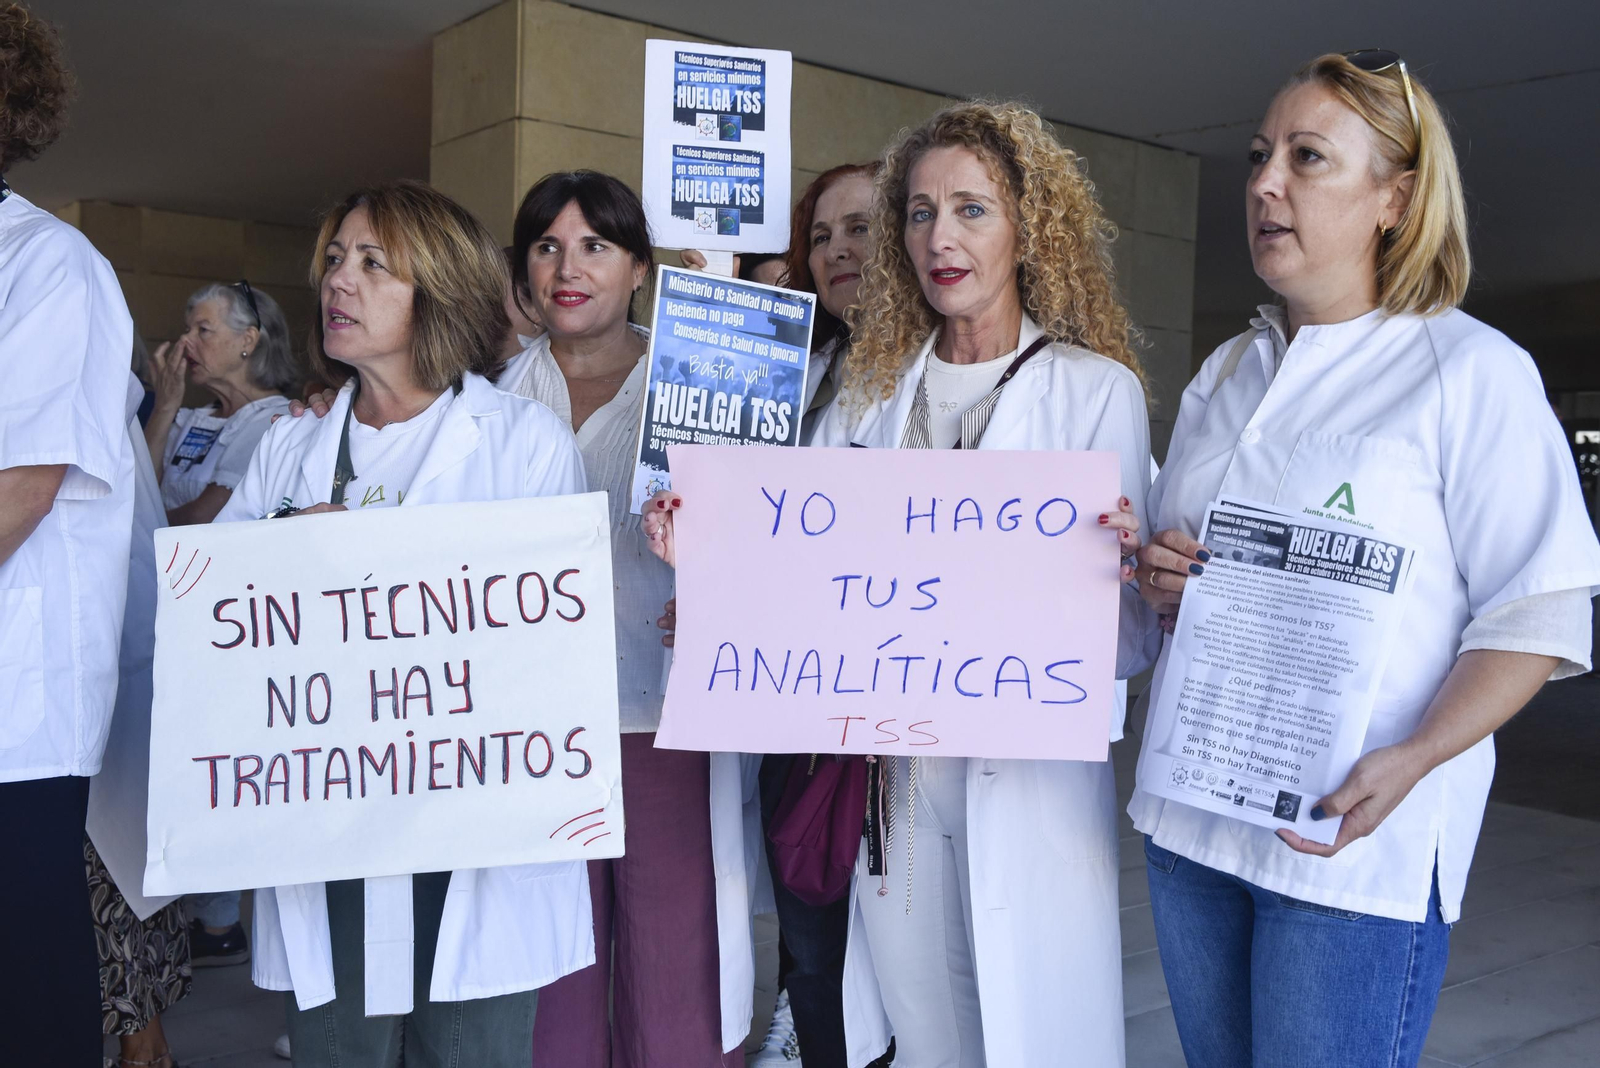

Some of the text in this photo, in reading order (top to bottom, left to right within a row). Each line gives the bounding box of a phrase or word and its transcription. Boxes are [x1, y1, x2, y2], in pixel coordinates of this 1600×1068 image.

[678, 53, 762, 72] Técnicos Superiores Sanitarios
[678, 71, 761, 85] en servicios mínimos
[677, 85, 762, 114] HUELGA TSS
[676, 147, 760, 165] Técnicos Superiores Sanitarios
[676, 164, 760, 178] en servicios mínimos
[675, 178, 760, 206] HUELGA TSS
[668, 275, 804, 320] Ministerio de Sanidad no cumple
[666, 302, 744, 326] Hacienda no paga
[674, 322, 799, 364] Consejerías de Salud nos ignoran
[689, 354, 734, 380] Basta
[652, 382, 792, 442] HUELGA TSS
[650, 438, 659, 450] 30
[660, 443, 666, 452] y
[652, 424, 692, 442] Técnicos
[694, 430, 742, 446] Superiores
[744, 438, 786, 447] Sanit
[761, 486, 1078, 538] YO HAGO
[1212, 512, 1235, 523] Ministerio
[1235, 517, 1242, 525] de
[1241, 518, 1260, 529] Sanidad
[1266, 524, 1284, 534] cumple
[1302, 507, 1324, 517] Junta
[1210, 524, 1231, 533] Hacienda
[1238, 529, 1251, 537] paga
[1288, 526, 1400, 573] HUELGA TSS
[1230, 565, 1251, 573] usuario
[1262, 571, 1283, 579] sistema
[1283, 575, 1311, 585] sanitario:
[1284, 562, 1292, 570] 30
[1295, 564, 1303, 572] 31
[1310, 567, 1331, 577] octubre
[1349, 575, 1358, 583] de
[1357, 577, 1389, 591] noviembre
[1286, 553, 1391, 582] Técnicos Superiores Sanitarios
[832, 574, 942, 610] TUS
[1226, 603, 1335, 631] ¿Quiénes somos los TSS?
[1193, 624, 1210, 632] Somos
[1232, 633, 1257, 643] hacemos
[1299, 648, 1327, 658] Anatomía
[1327, 654, 1359, 666] Patológica
[267, 660, 474, 728] NO HAY
[1184, 676, 1195, 684] Que
[1203, 682, 1223, 691] mejore
[1223, 687, 1245, 696] nuestra
[1246, 692, 1274, 703] formación
[1279, 700, 1297, 709] Grado
[1298, 704, 1335, 718] Universitario
[1228, 676, 1296, 697] ¿Qué pedimos?
[1183, 684, 1195, 692] Que
[1205, 691, 1227, 700] paguen
[1257, 703, 1275, 712] deben
[1275, 707, 1293, 716] desde
[1293, 711, 1307, 720] hace
[1316, 718, 1331, 726] años
[1191, 695, 1222, 707] reconozcan
[1223, 704, 1245, 713] nuestro
[1246, 709, 1269, 718] carácter
[1277, 716, 1304, 728] Profesión
[1305, 723, 1331, 735] Sanitaria
[827, 716, 938, 746] TSS
[1176, 702, 1329, 747] No queremos que nos regalen nada
[1180, 715, 1224, 733] Queremos
[1225, 729, 1243, 738] que
[1256, 736, 1288, 750] cumpla
[1290, 743, 1298, 753] la
[1300, 746, 1317, 758] Ley
[1181, 745, 1194, 755] Sin
[1197, 749, 1212, 760] TSS
[1213, 755, 1225, 763] no
[1227, 757, 1244, 770] hay
[1246, 762, 1299, 784] Tratamiento
[1186, 733, 1301, 771] Sin TSS no hay Diagnóstico
